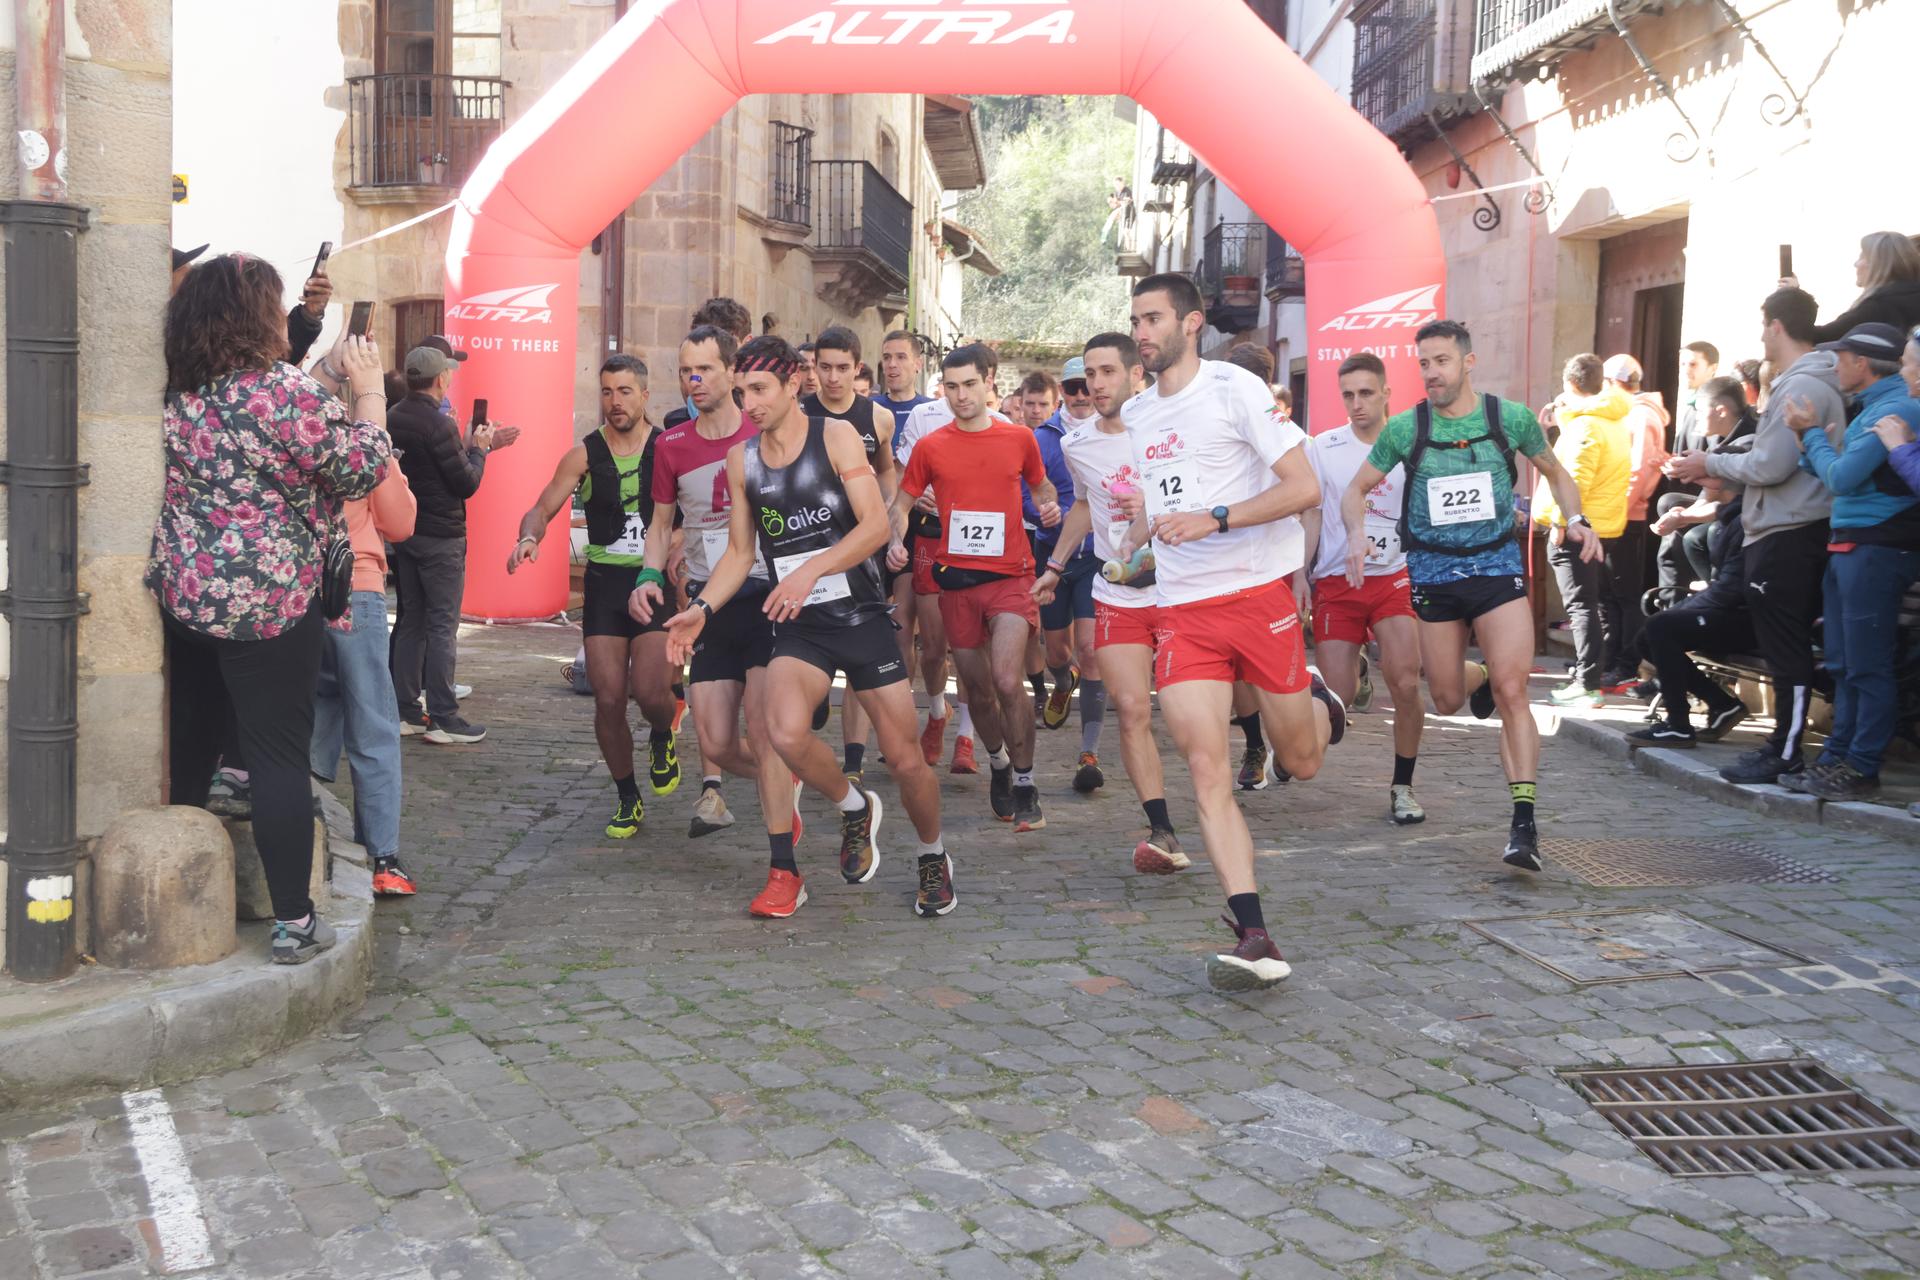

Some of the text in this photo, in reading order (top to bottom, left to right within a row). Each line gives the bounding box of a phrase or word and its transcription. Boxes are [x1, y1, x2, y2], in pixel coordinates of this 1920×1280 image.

[752, 10, 1076, 45] ALTRA
[446, 304, 552, 324] ALTRA
[471, 336, 503, 350] OUT
[512, 338, 560, 353] THERE
[1317, 347, 1352, 361] STAY
[1159, 475, 1183, 497] 12
[1163, 498, 1181, 507] URKO
[1442, 488, 1481, 508] 222
[787, 506, 832, 531] aike
[1444, 507, 1480, 516] RUBENTXO
[960, 525, 994, 540] 127
